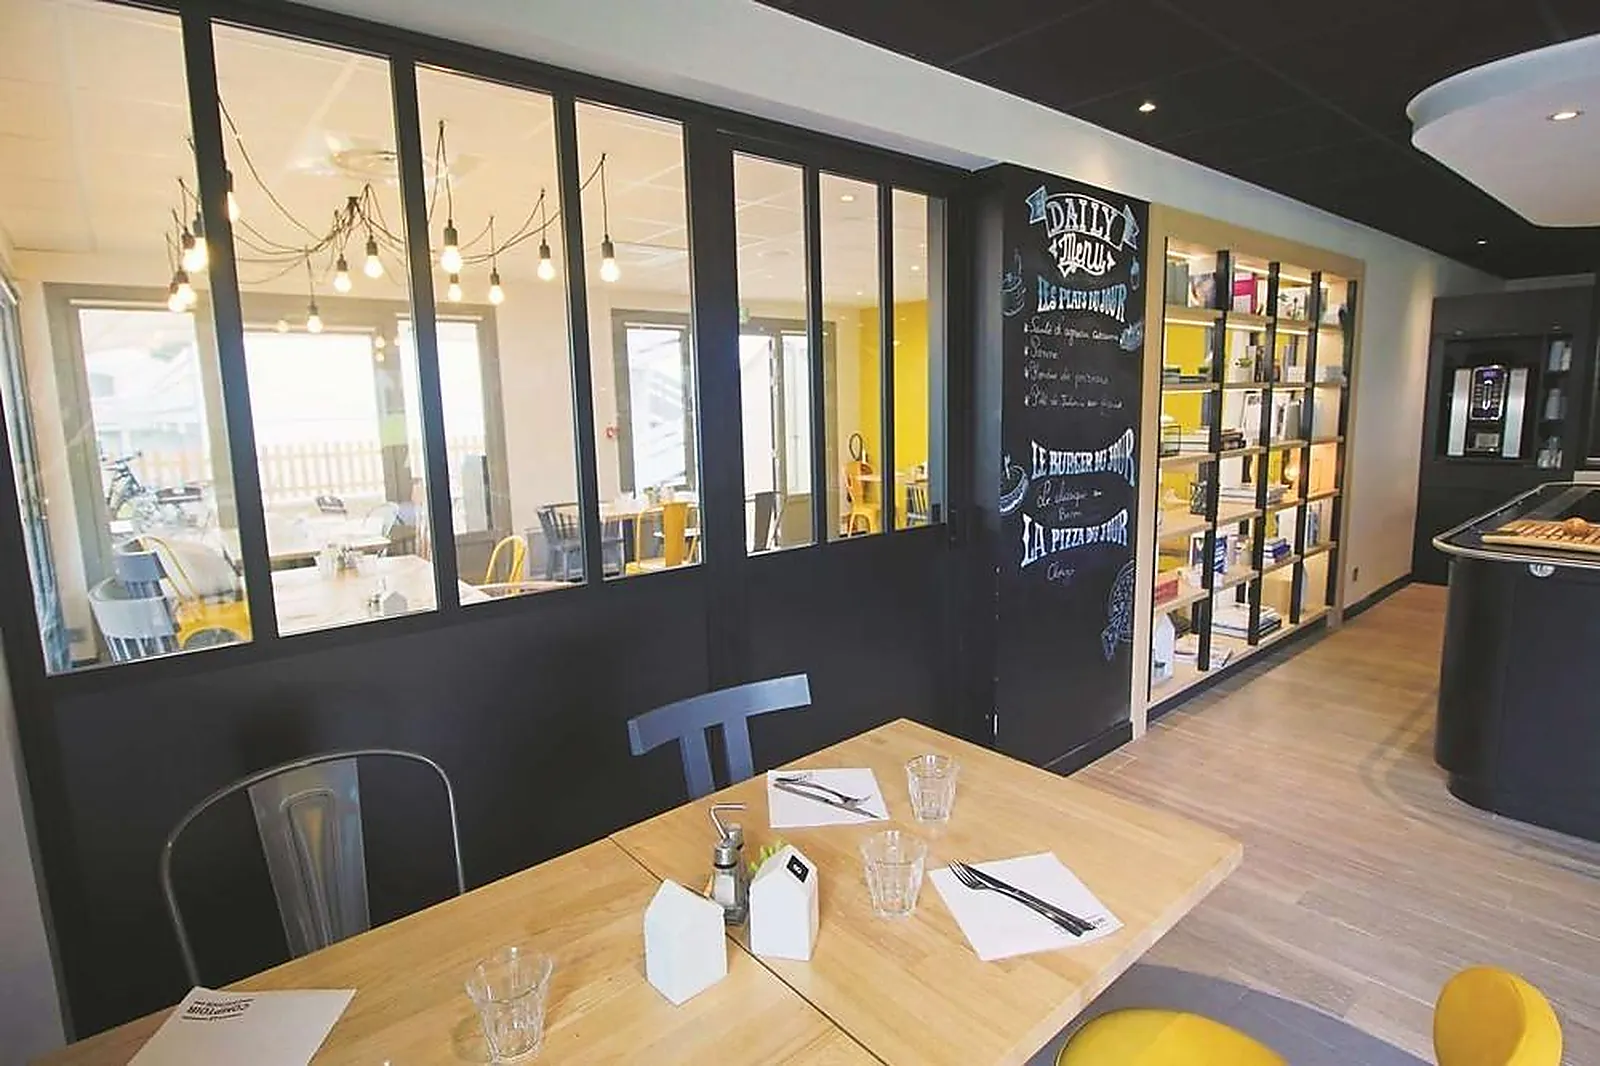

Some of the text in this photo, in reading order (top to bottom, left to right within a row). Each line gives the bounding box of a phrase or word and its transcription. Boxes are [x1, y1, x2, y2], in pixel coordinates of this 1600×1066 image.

[1046, 198, 1118, 242] DAILY
[1057, 232, 1107, 278] Menu
[1058, 287, 1087, 310] PLATS
[1101, 283, 1128, 323] JOUR
[1031, 428, 1135, 487] LE BURGER DU JOUR
[1020, 513, 1048, 568] LA
[1051, 527, 1085, 554] PIZZA
[1085, 526, 1100, 544] DU
[1100, 508, 1128, 547] JOUR
